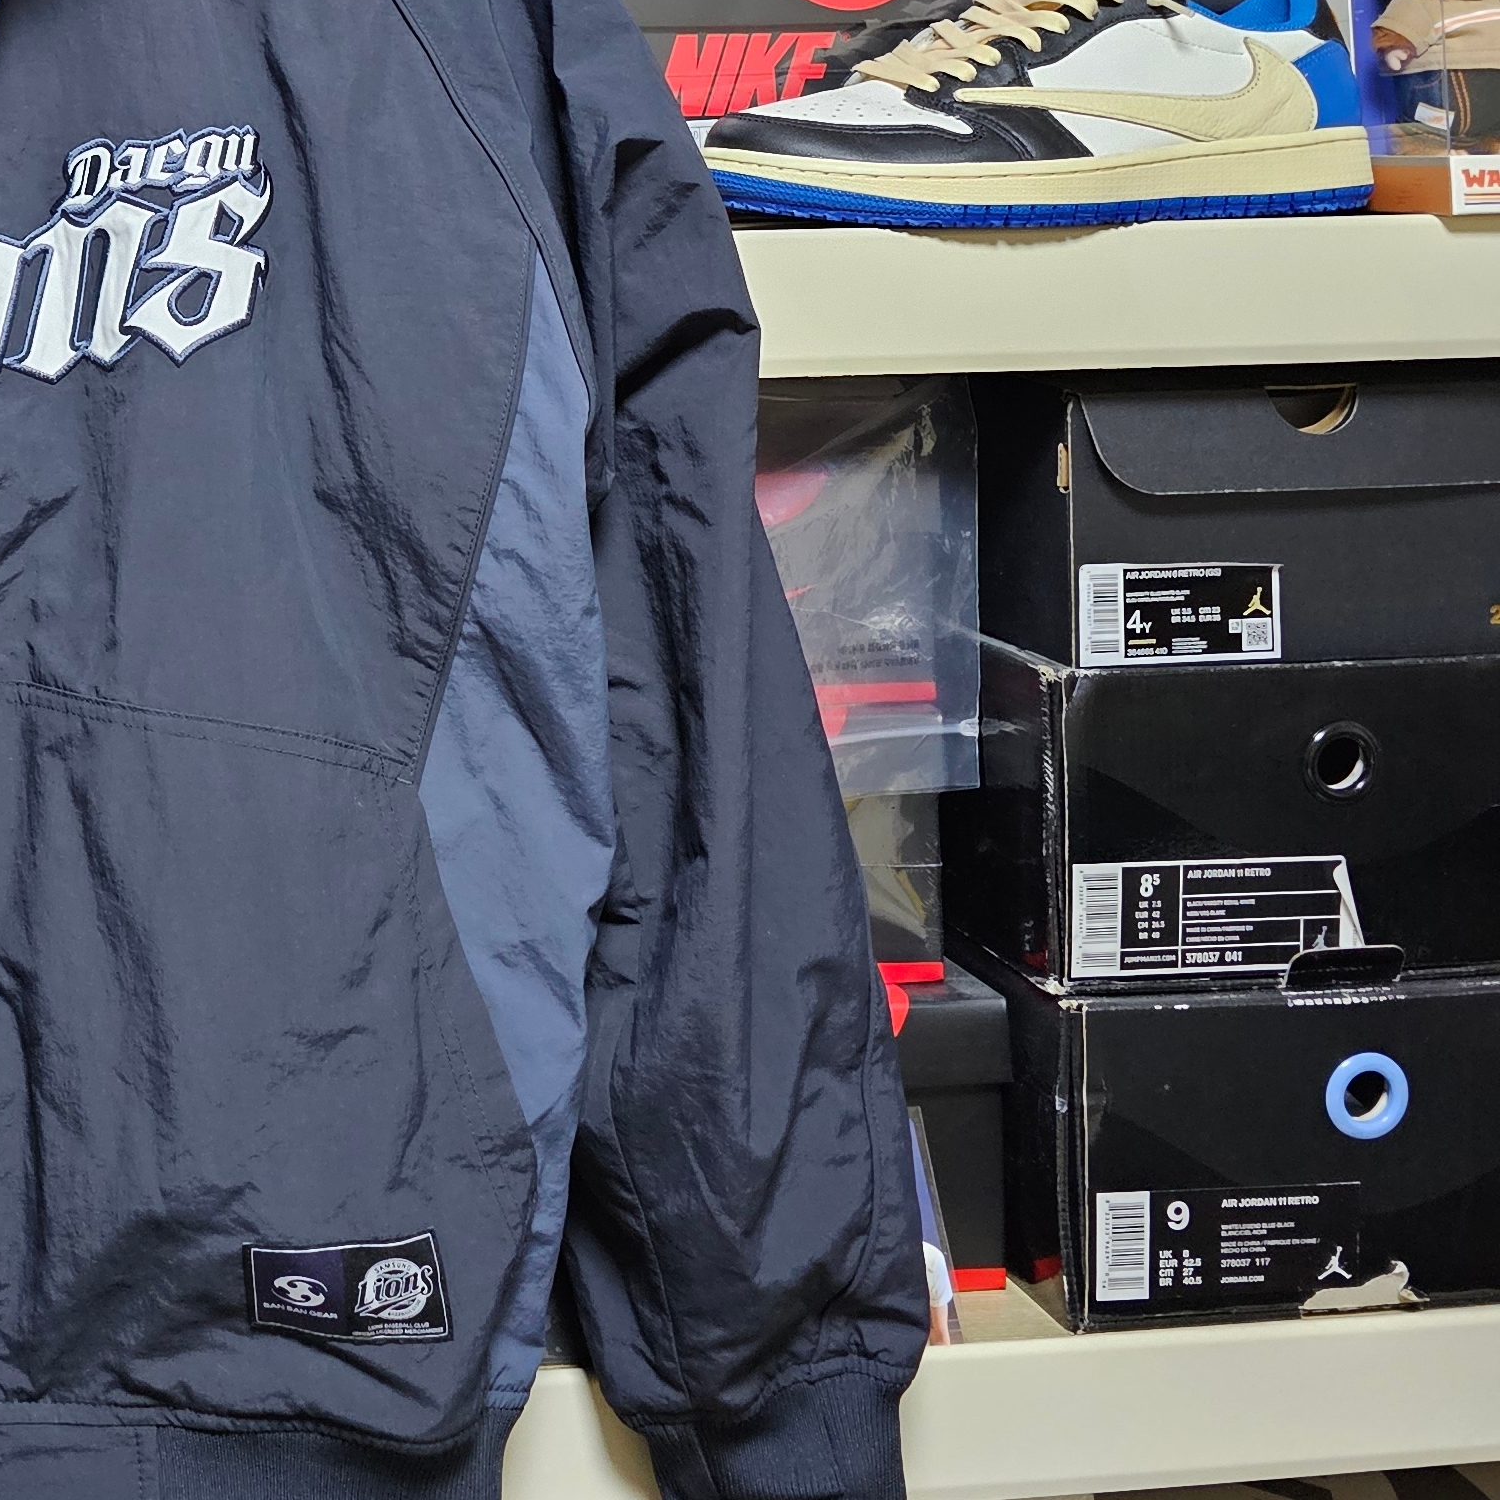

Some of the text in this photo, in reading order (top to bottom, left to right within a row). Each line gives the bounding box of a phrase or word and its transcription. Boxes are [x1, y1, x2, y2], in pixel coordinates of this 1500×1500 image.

[666, 32, 835, 117] NIKE
[1187, 868, 1201, 879] AIR
[1203, 868, 1235, 879] JORDAN
[1245, 868, 1271, 877] RETRO
[1221, 1199, 1237, 1208] AIR
[1239, 1198, 1276, 1208] JORDAN
[1288, 1196, 1319, 1206] RETRO
[1167, 1200, 1190, 1231] 9
